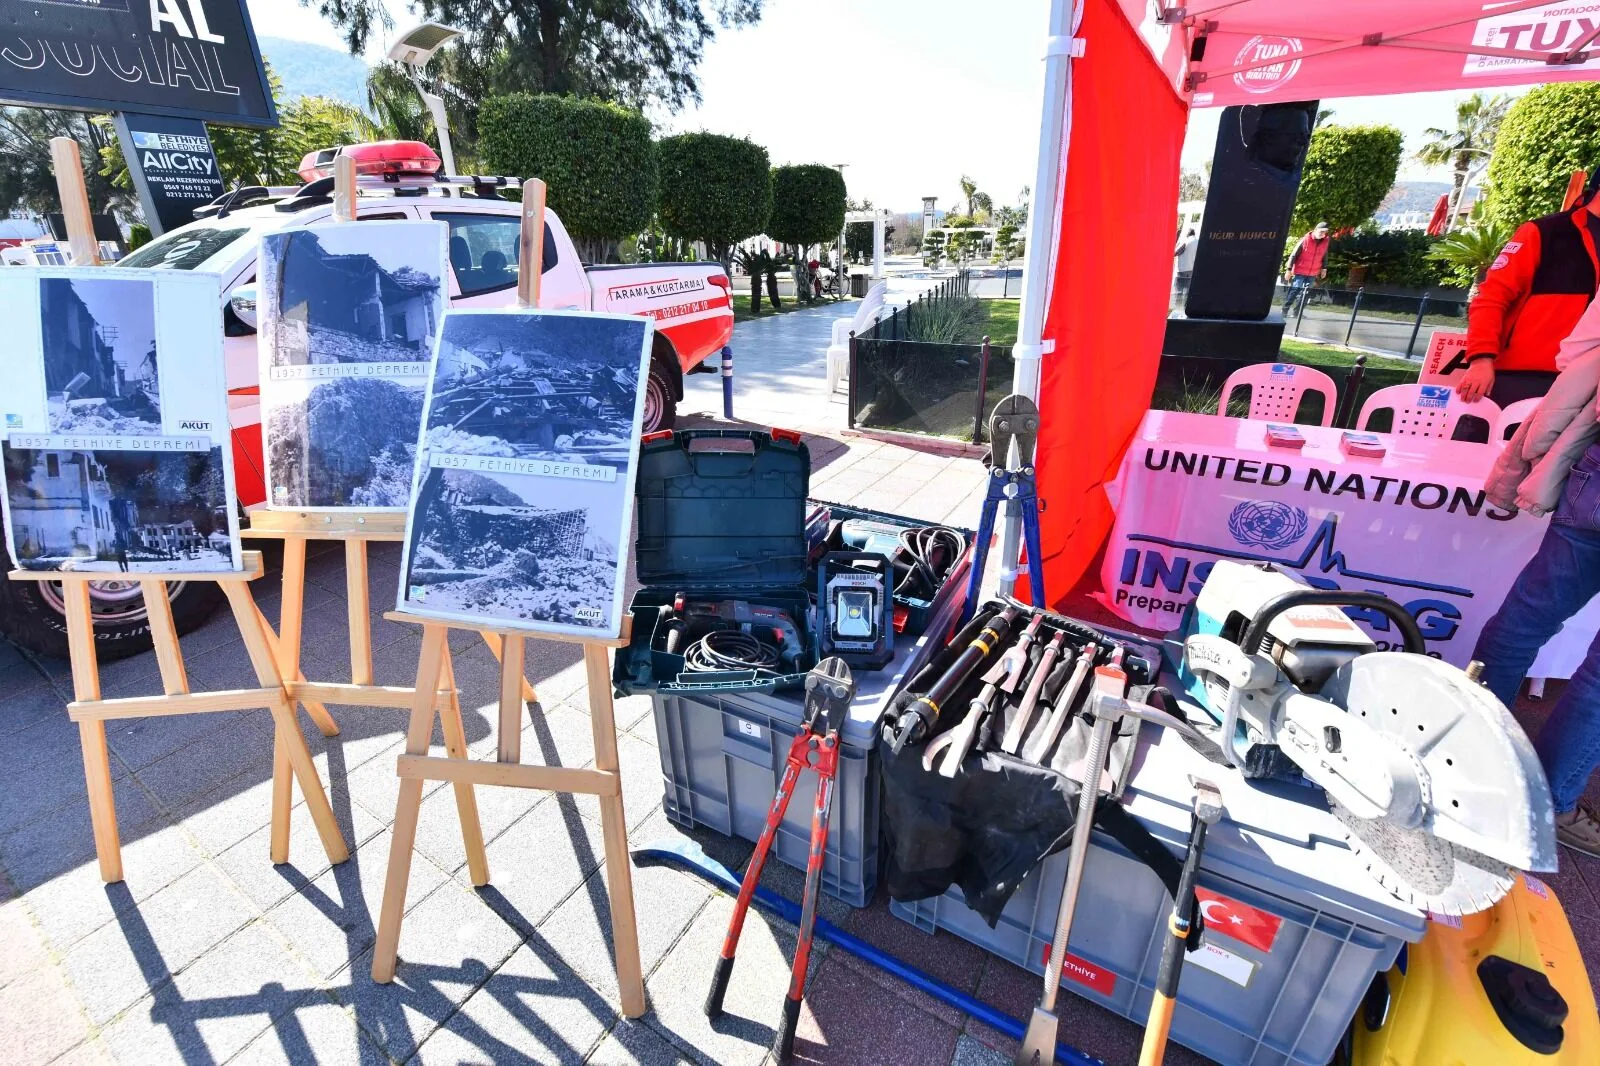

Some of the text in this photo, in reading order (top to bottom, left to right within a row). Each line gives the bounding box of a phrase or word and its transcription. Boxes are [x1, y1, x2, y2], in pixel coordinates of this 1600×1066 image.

[143, 151, 213, 175] AllCity
[147, 175, 221, 185] REKLAM REZERVASYON
[1429, 338, 1446, 375] SEARCH
[276, 367, 303, 378] 1957
[181, 422, 211, 430] AKUT
[16, 438, 51, 447] 1957
[436, 457, 468, 468] 1957
[1144, 448, 1292, 487] UNITED
[1115, 588, 1187, 614] Prepar
[577, 610, 601, 618] AKUT
[1063, 960, 1097, 980] ETHİYE
